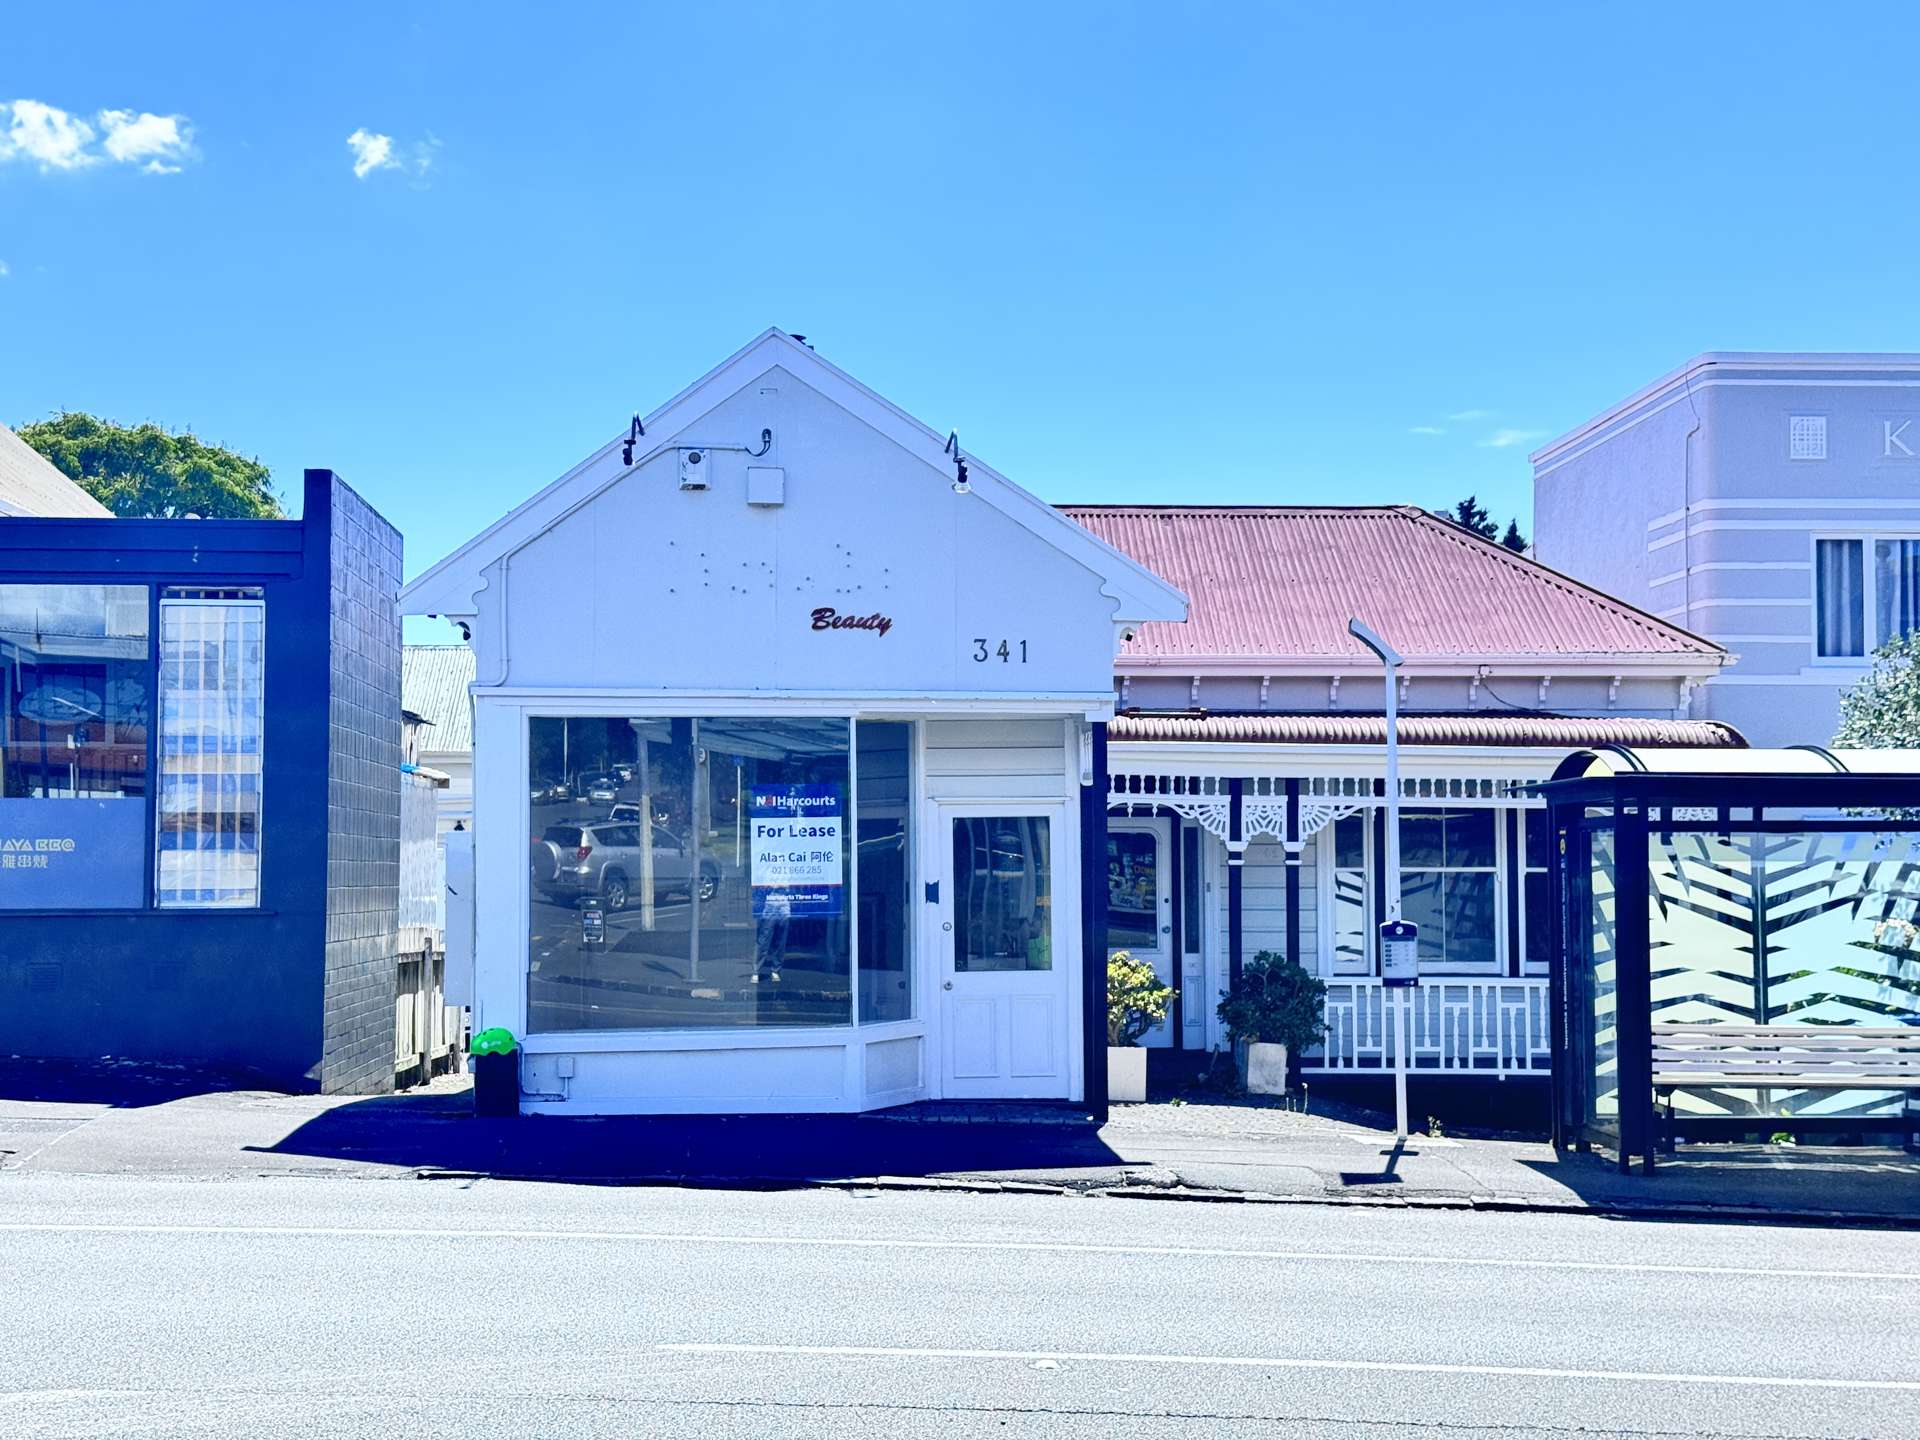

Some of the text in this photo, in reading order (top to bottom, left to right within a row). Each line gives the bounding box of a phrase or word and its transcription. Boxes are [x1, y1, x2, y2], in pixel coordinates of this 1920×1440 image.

[810, 607, 893, 638] Beauty
[973, 638, 1028, 664] 341
[777, 796, 836, 807] Harcourts
[757, 825, 836, 838] For Lease
[0, 838, 33, 851] AYA
[759, 852, 785, 863] Alan
[788, 852, 806, 863] Cai
